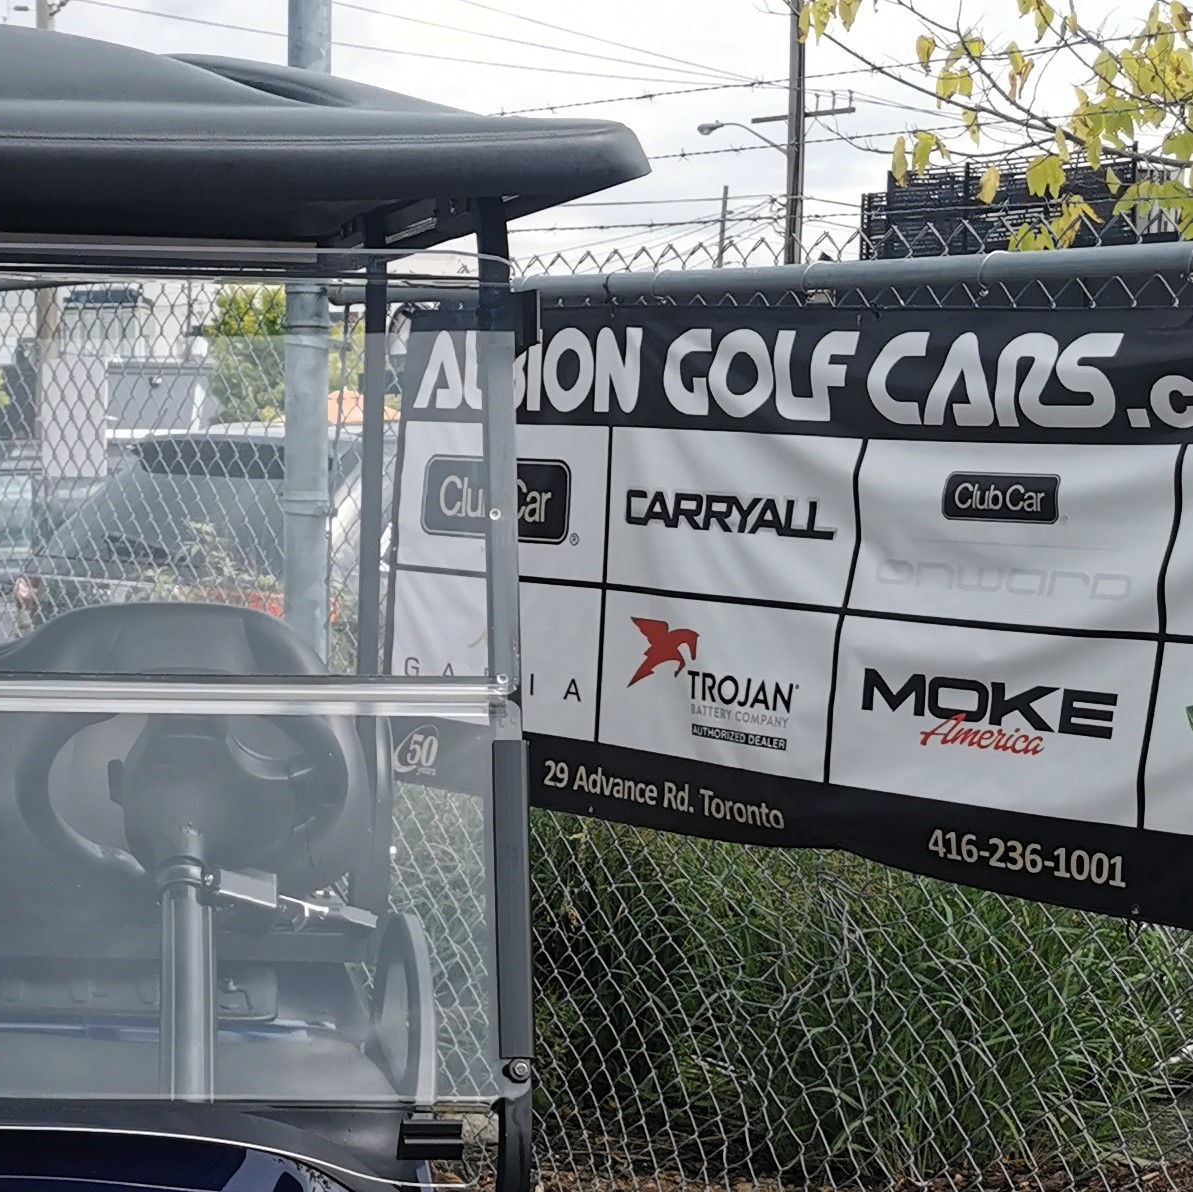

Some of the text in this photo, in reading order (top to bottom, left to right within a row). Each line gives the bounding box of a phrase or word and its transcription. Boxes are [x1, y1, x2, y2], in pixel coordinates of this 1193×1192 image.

[413, 327, 644, 414] ALION
[663, 328, 861, 422] GOLF
[439, 475, 486, 518] Clu
[626, 488, 836, 541] CARRYALL
[954, 482, 1046, 513] Club Car
[404, 656, 582, 703] GAIA
[687, 670, 794, 714] TROJAN
[690, 703, 790, 729] BATTERY COMPANY
[861, 667, 1119, 740] MOKE
[406, 733, 439, 767] 50
[692, 725, 786, 750] AUTHORIZED DEALER
[919, 712, 1046, 756] America
[543, 760, 785, 830] 29 Advance Rd. Toronto
[928, 829, 1127, 889] 416-236-1001
